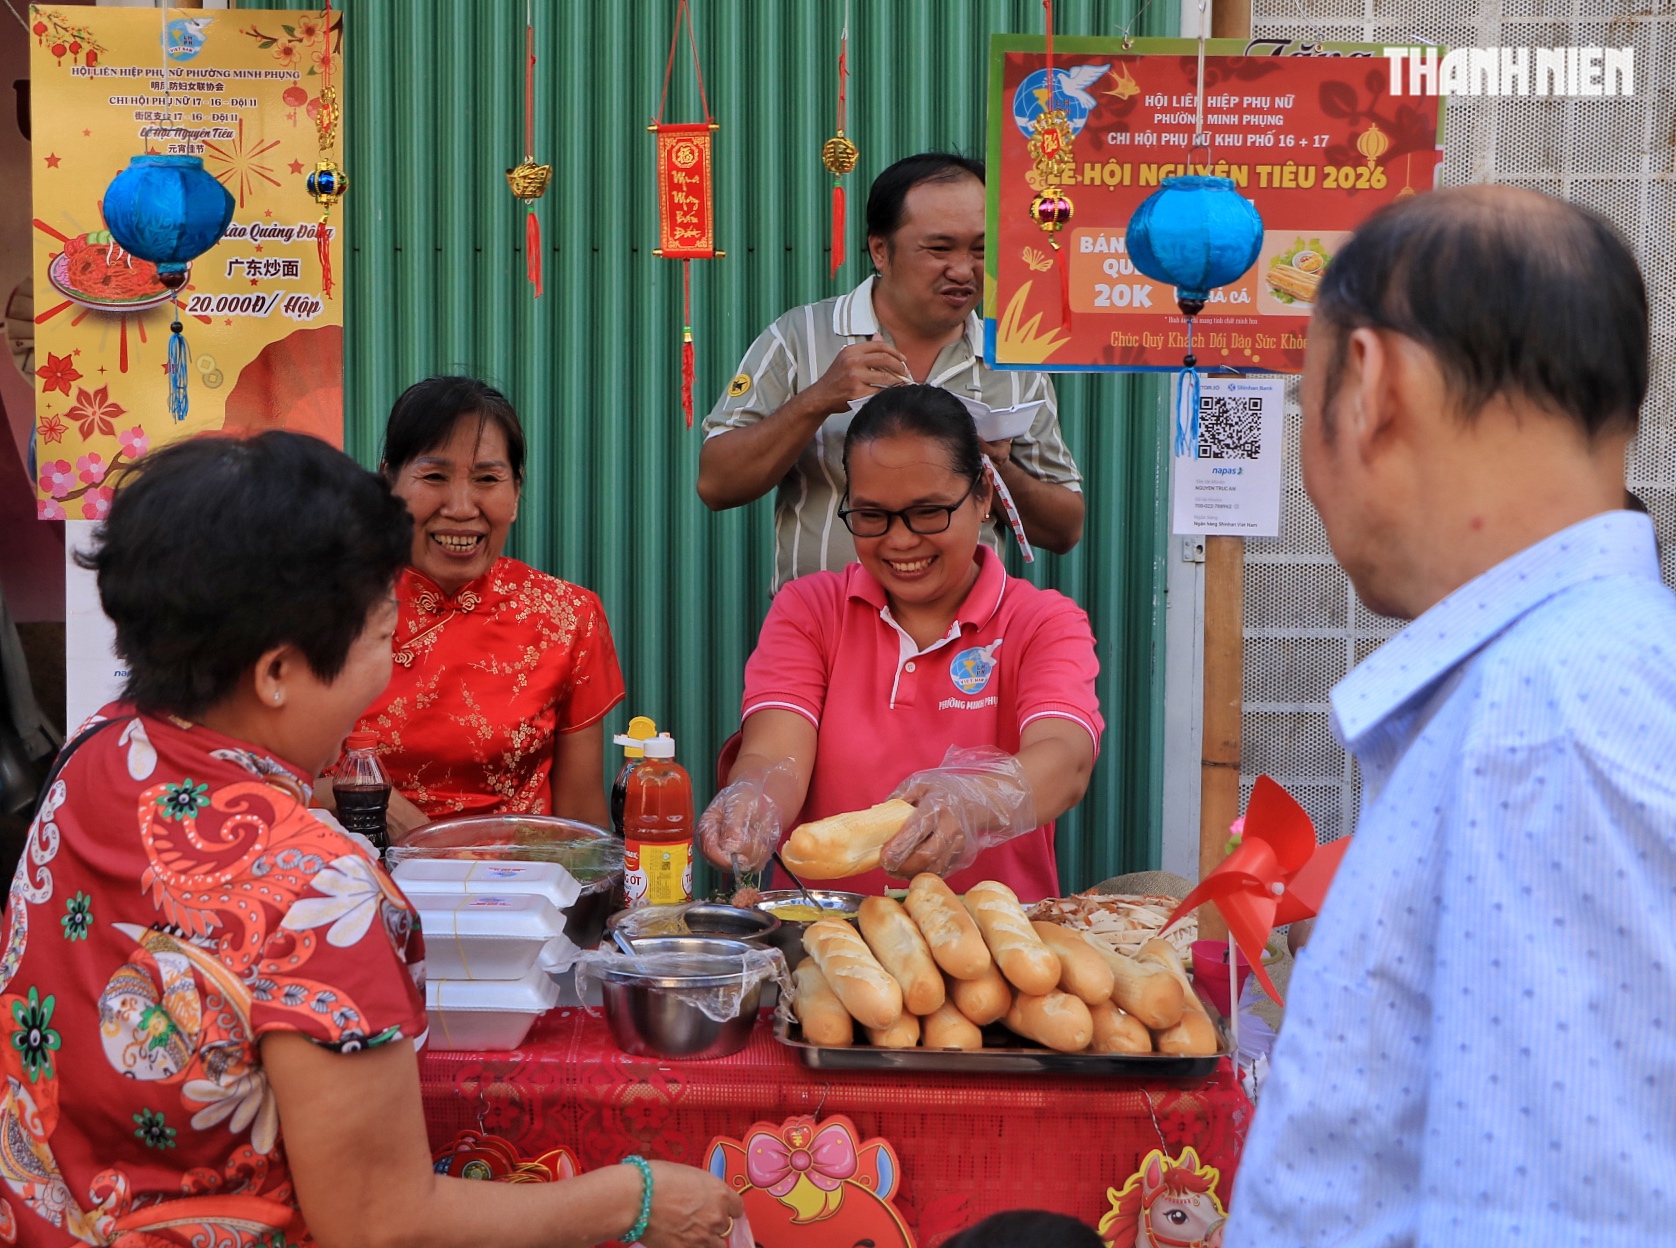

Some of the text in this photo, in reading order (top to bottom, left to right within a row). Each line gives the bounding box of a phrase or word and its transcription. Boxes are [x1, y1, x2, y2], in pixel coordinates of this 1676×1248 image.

[72, 66, 300, 80] HỘI LIÊN HIỆP PHỤ NỮ PHƯỜNG MINH PHỤNG
[131, 95, 149, 106] HỘI
[152, 97, 172, 107] PHỤ
[176, 96, 190, 105] NỮ
[193, 98, 201, 106] 17
[211, 98, 221, 106] 16
[231, 98, 247, 108] Đội
[1145, 92, 1168, 109] HỘI
[1207, 93, 1239, 110] HIỆP
[1243, 96, 1270, 110] PHỤ
[1275, 94, 1295, 108] NỮ
[174, 112, 182, 121] 17
[192, 113, 202, 121] 16
[212, 113, 228, 123] Đội
[1207, 114, 1238, 125] MINH
[1243, 115, 1284, 127] PHỤNG
[174, 127, 211, 140] Nguyên
[213, 128, 234, 138] Tiêu
[1108, 132, 1130, 144] CHI
[1134, 130, 1157, 148] HỘI
[1161, 133, 1188, 148] PHỤ
[1192, 131, 1212, 146] NỮ
[1215, 134, 1242, 146] KHU
[1247, 130, 1276, 147] PHỐ
[1279, 135, 1295, 147] 16
[1313, 135, 1330, 147] 17
[168, 144, 204, 154] 元宵佳节
[1084, 158, 1131, 191] HỘI
[1139, 160, 1248, 188] NGUYÊN
[1256, 160, 1316, 188] TIÊU
[1322, 166, 1387, 189] 2026
[250, 222, 294, 242] Quảng
[297, 224, 334, 239] Đôg
[1080, 234, 1128, 253] BÁN
[227, 259, 299, 277] 广东炒面
[1103, 259, 1143, 278] QU
[1094, 284, 1153, 308] 20K
[1204, 287, 1251, 304] HẢ CÁ
[284, 296, 321, 318] Hộp
[1110, 331, 1139, 347] Chúc
[1143, 332, 1164, 350] Quý
[1168, 332, 1204, 348] Khách
[1231, 333, 1252, 348] Dào
[1255, 334, 1276, 348] Sức
[1212, 468, 1236, 476] napas
[939, 697, 965, 710] PHƯỜNG
[985, 696, 998, 707] PHỤ
